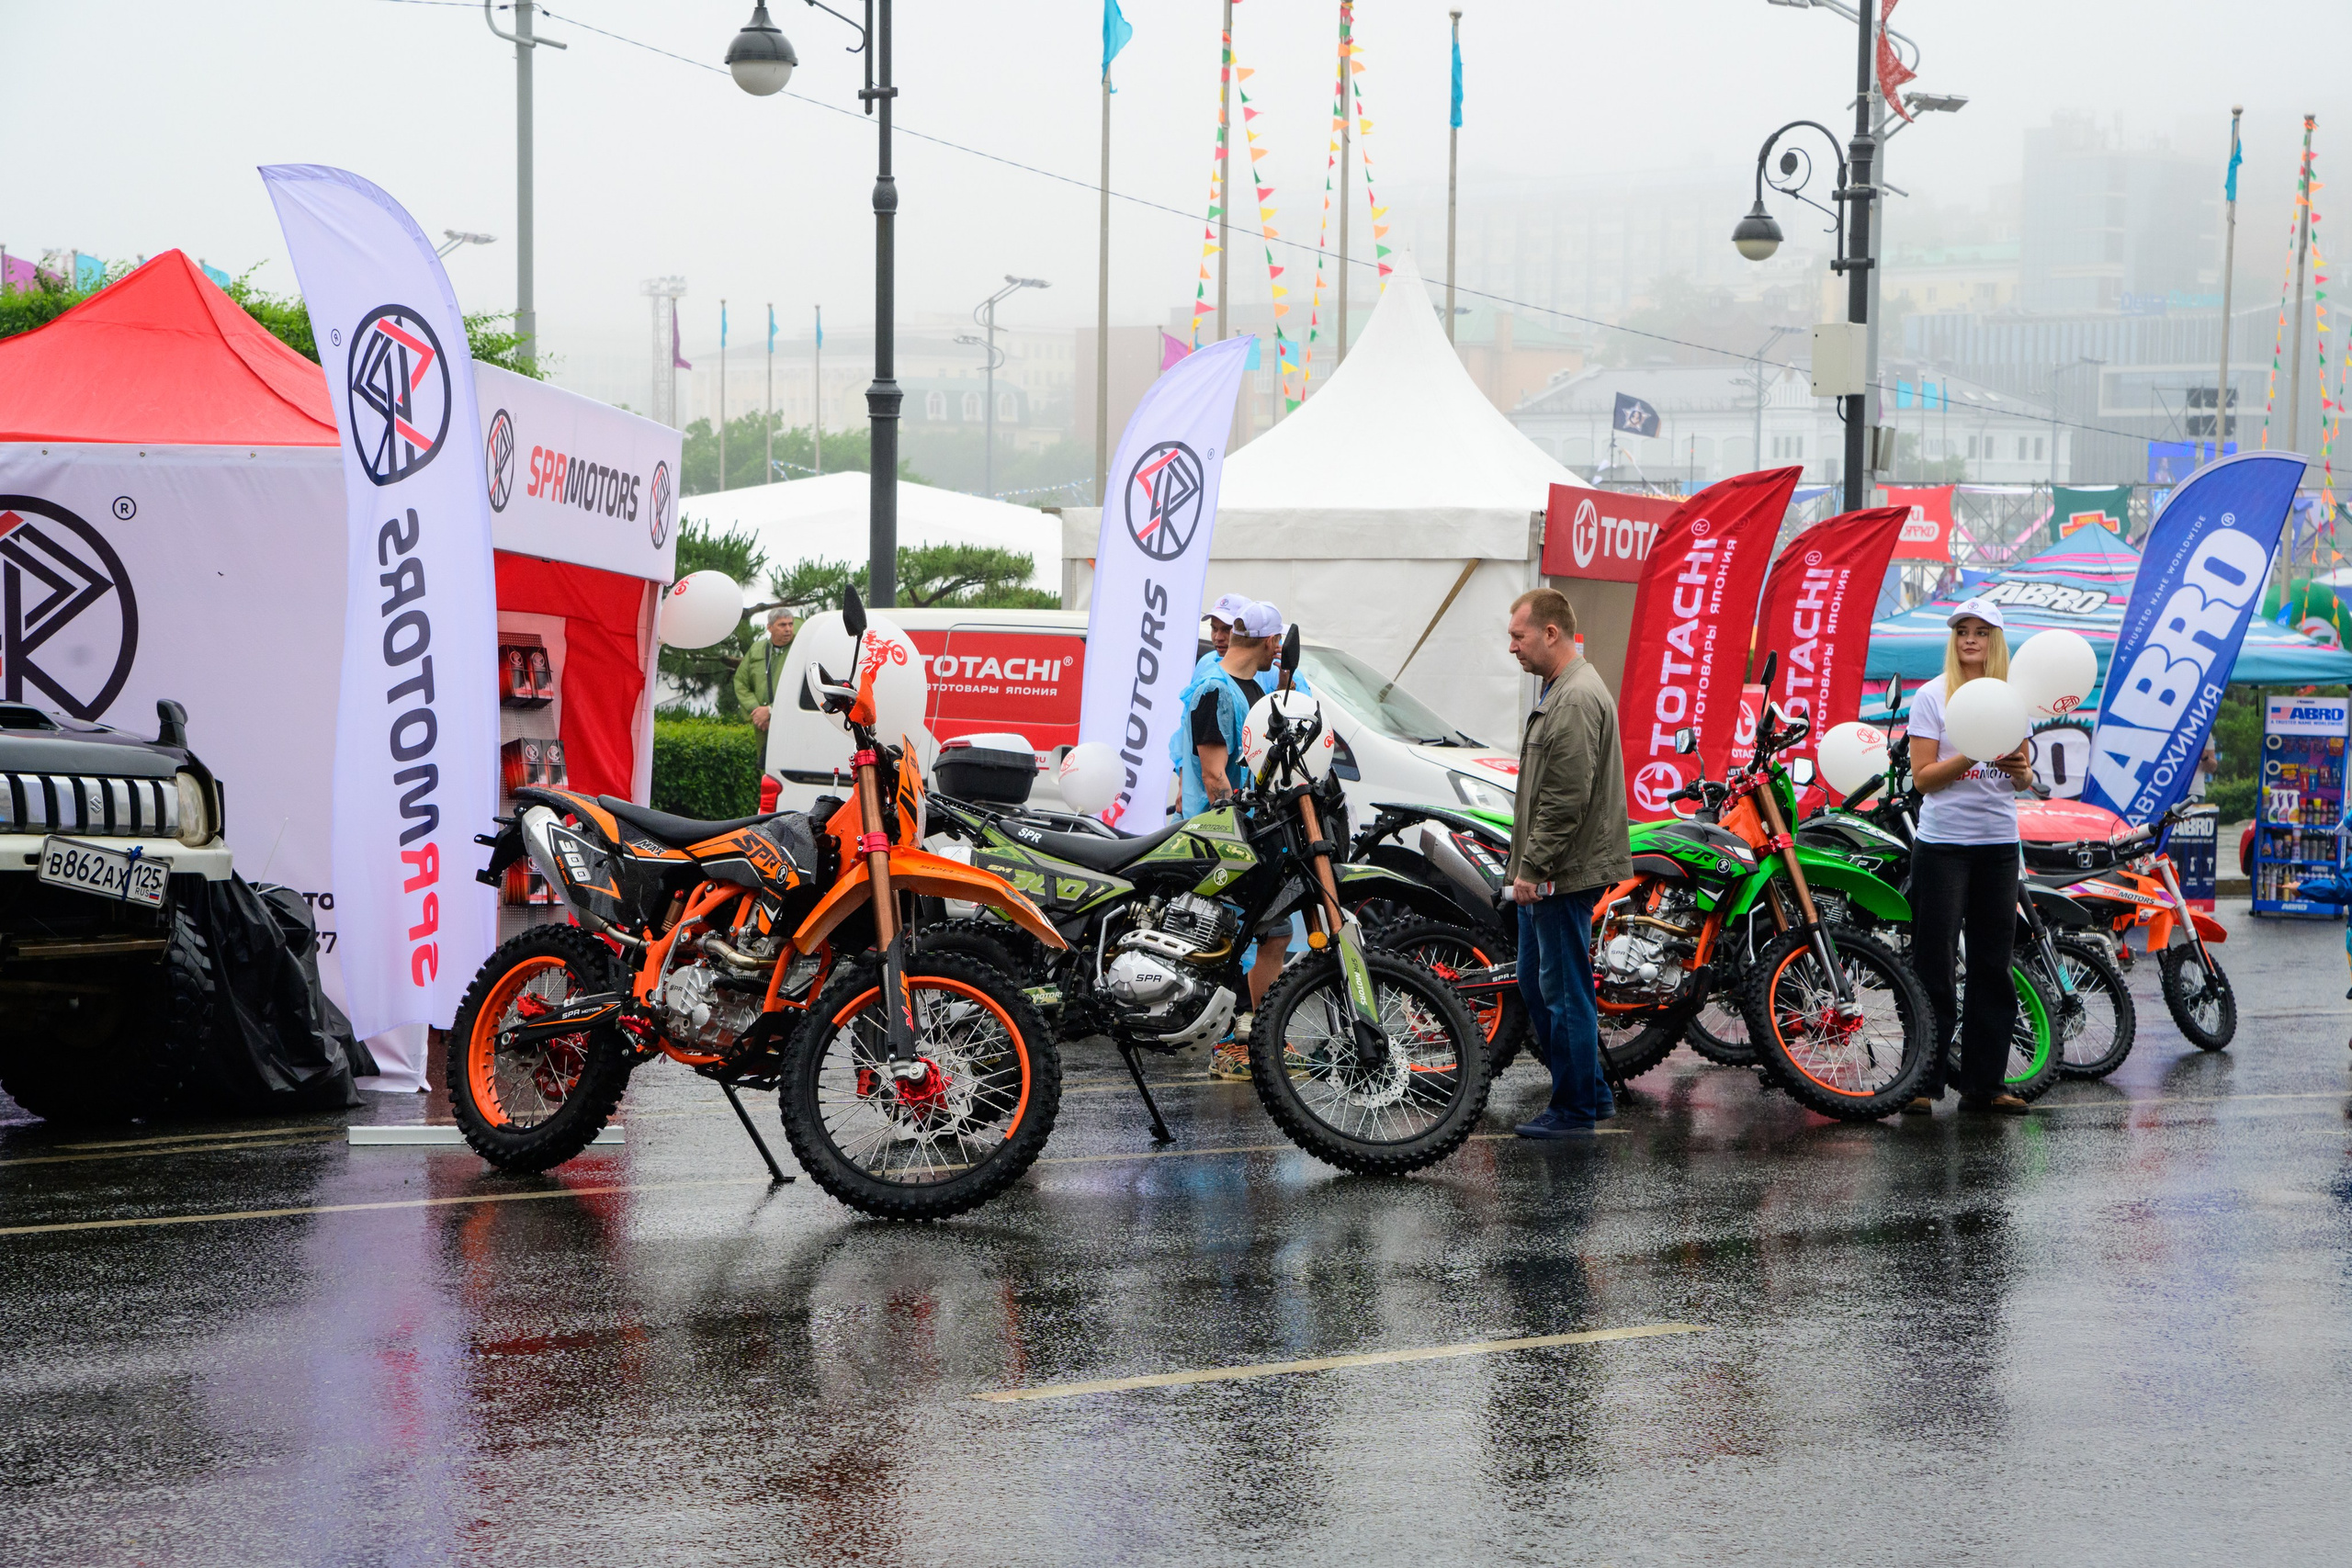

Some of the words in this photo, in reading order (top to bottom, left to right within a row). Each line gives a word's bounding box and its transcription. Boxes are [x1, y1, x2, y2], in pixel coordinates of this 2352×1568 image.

[526, 446, 640, 523] SPRMOTORS
[1710, 539, 1737, 615] ЯПОНИЯ
[2125, 609, 2152, 651] TRUSTED
[2150, 578, 2169, 606] NAME
[2166, 514, 2207, 575] WORLDWIDE
[1979, 580, 2109, 615] ABRO
[1814, 643, 1835, 750] ВТОТОВАРЫ
[1826, 569, 1850, 634] ЯПОНИЯ
[2089, 528, 2267, 813] ABRO
[1005, 686, 1058, 696] ЯПОНИЯ
[2289, 706, 2346, 721] ABRO
[2126, 682, 2223, 829] АВТОХИМИЯ
[1018, 828, 1043, 844] SPR
[2171, 817, 2214, 837] ABRO
[632, 839, 668, 858] MAX
[558, 840, 592, 882] 300
[134, 864, 163, 890] 125
[134, 887, 150, 897] RUS
[2102, 887, 2154, 905] SPRMOTORS
[1136, 974, 1162, 983] SPR
[1351, 957, 1368, 1006] SPRMOTORS
[1492, 973, 1510, 982] SPR
[561, 1009, 581, 1020] SPR
